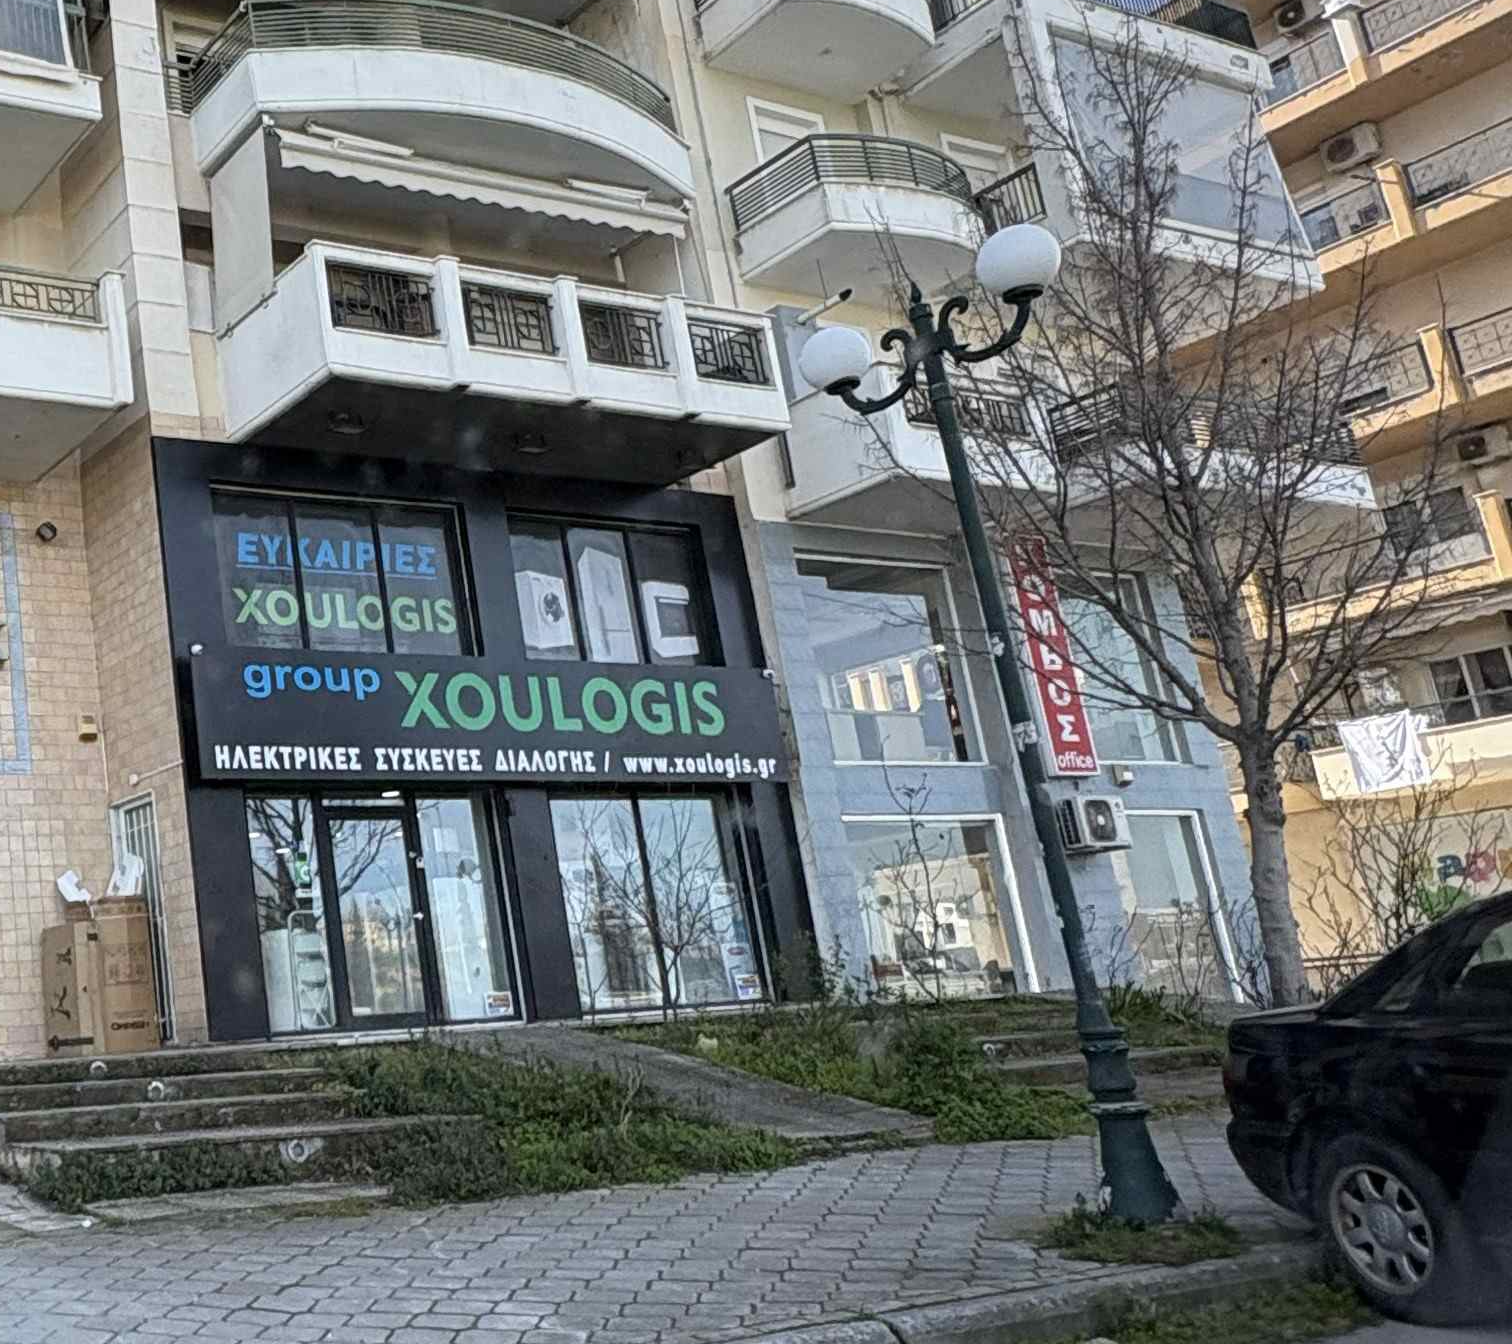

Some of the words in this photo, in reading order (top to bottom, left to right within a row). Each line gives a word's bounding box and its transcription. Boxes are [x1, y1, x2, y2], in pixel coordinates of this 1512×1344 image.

[236, 532, 438, 575] ΕΥΚΑΙΡΙΕΣ
[232, 586, 457, 634] XOULOGIS
[243, 662, 380, 701] group
[394, 669, 726, 737] XOULOGIS
[214, 744, 362, 771] ΗΛΕΚΤΡΙΚΕΣ
[374, 747, 483, 773] ΣΥΣΚΕΥΕΣ
[494, 749, 597, 774] ΔΙΑΛΟΓΗΣ
[623, 752, 777, 779] www.xoulogis.gr
[1057, 750, 1094, 769] office
